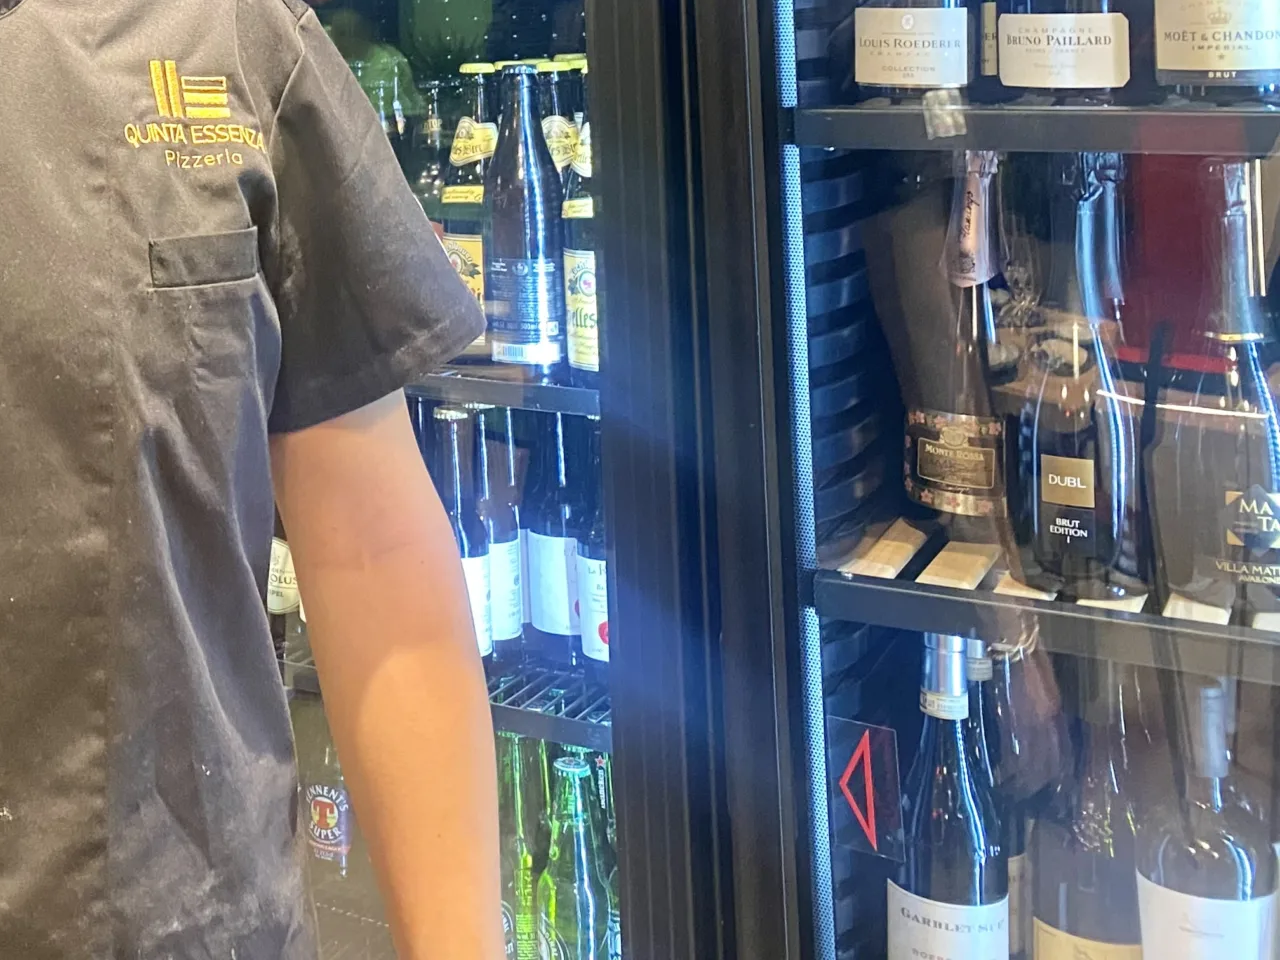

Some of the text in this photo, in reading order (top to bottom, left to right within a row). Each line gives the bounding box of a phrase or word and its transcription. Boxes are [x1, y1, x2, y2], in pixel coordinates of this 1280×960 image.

[859, 38, 961, 49] LOUIS ROEDERER
[1006, 34, 1042, 46] BRUNO
[1046, 34, 1112, 46] PAILLARD
[1208, 71, 1238, 79] BRUT
[124, 123, 269, 154] QUINTA ESSENZA
[164, 149, 244, 169] Pizzeria
[925, 443, 954, 456] MONTE
[1048, 473, 1087, 488] DUBL
[1239, 498, 1274, 516] MA
[1055, 517, 1081, 528] BRUT
[1049, 525, 1089, 538] EDITION
[1215, 560, 1249, 574] VILLA
[310, 820, 343, 840] SUPER
